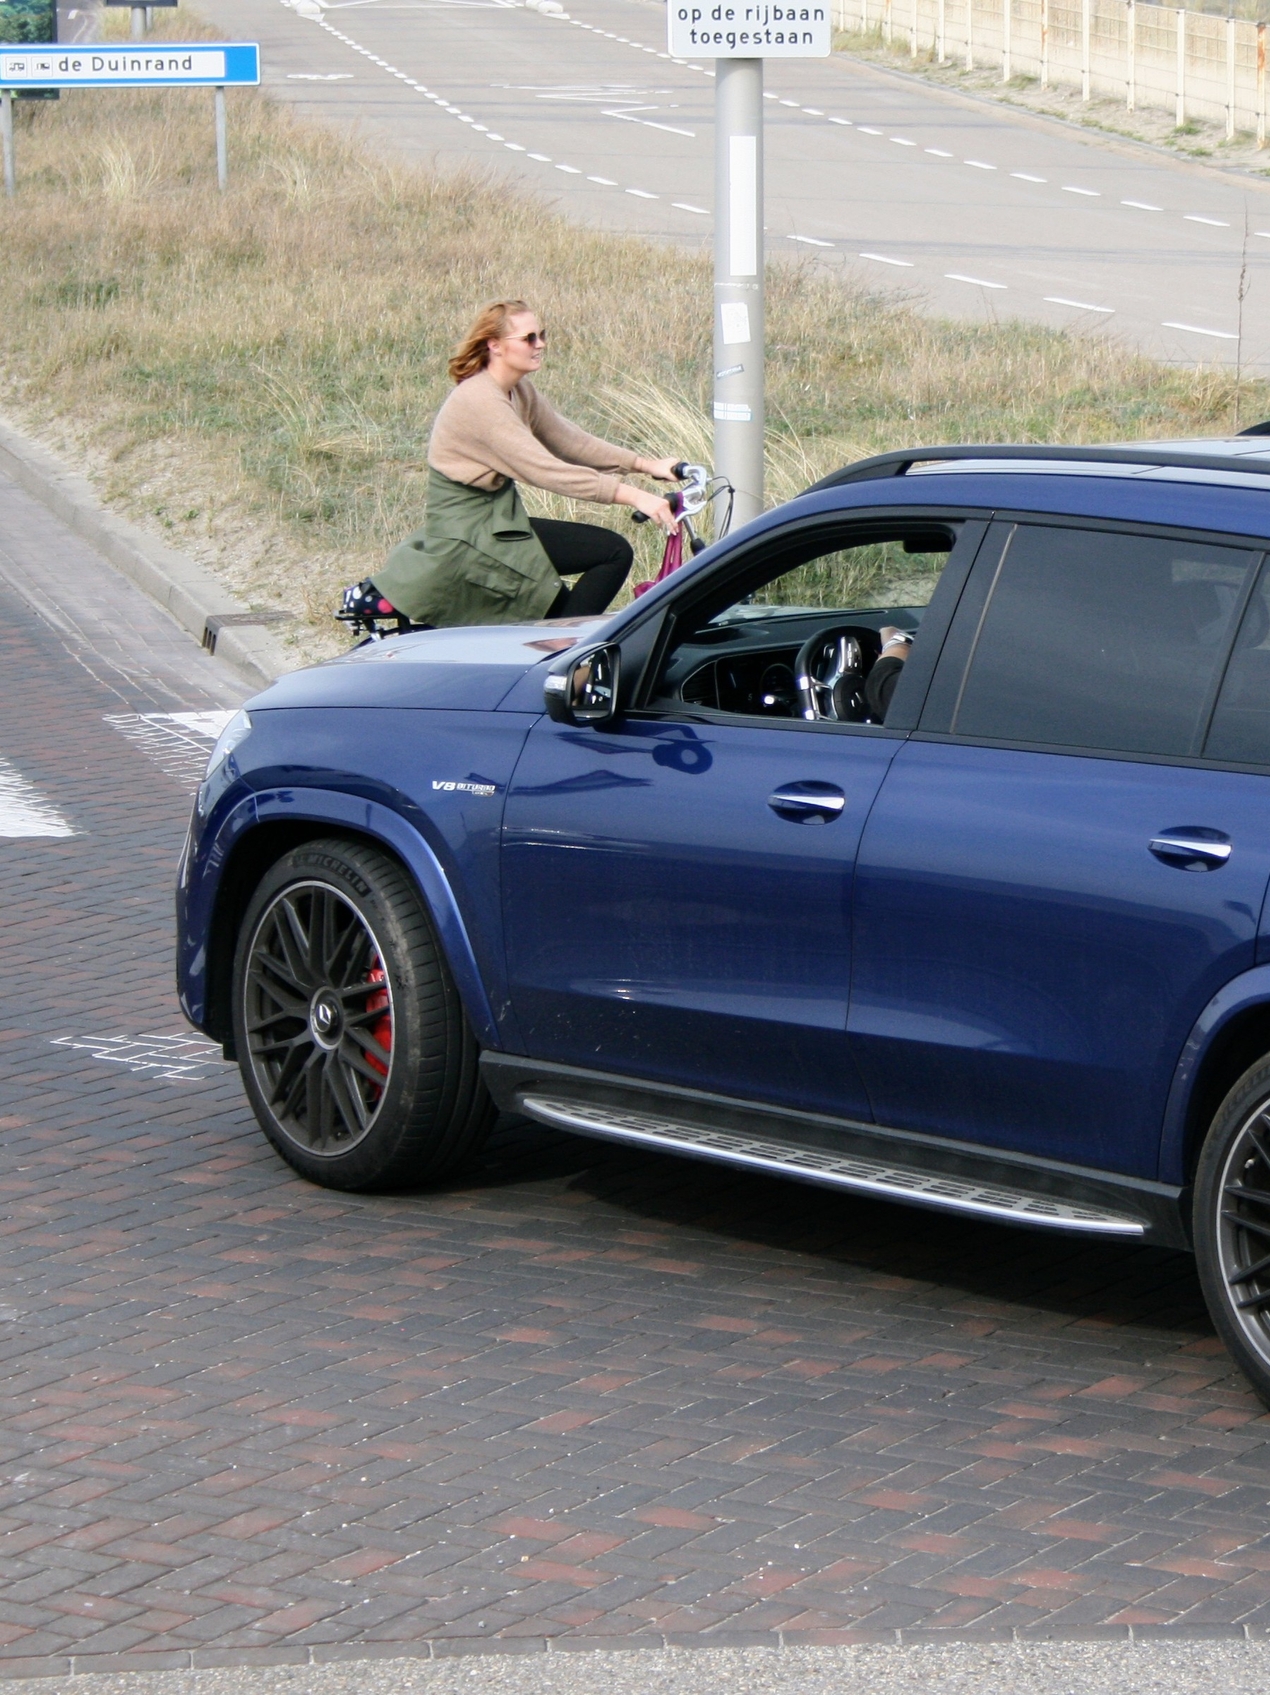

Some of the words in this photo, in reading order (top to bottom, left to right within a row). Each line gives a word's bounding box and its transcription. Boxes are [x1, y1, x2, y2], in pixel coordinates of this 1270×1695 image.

[678, 8, 702, 24] op
[711, 5, 735, 21] de
[745, 5, 824, 26] rijbaan
[690, 29, 813, 49] toegestaan
[58, 56, 82, 72] de
[92, 55, 193, 72] Duinrand
[432, 780, 456, 791] V8
